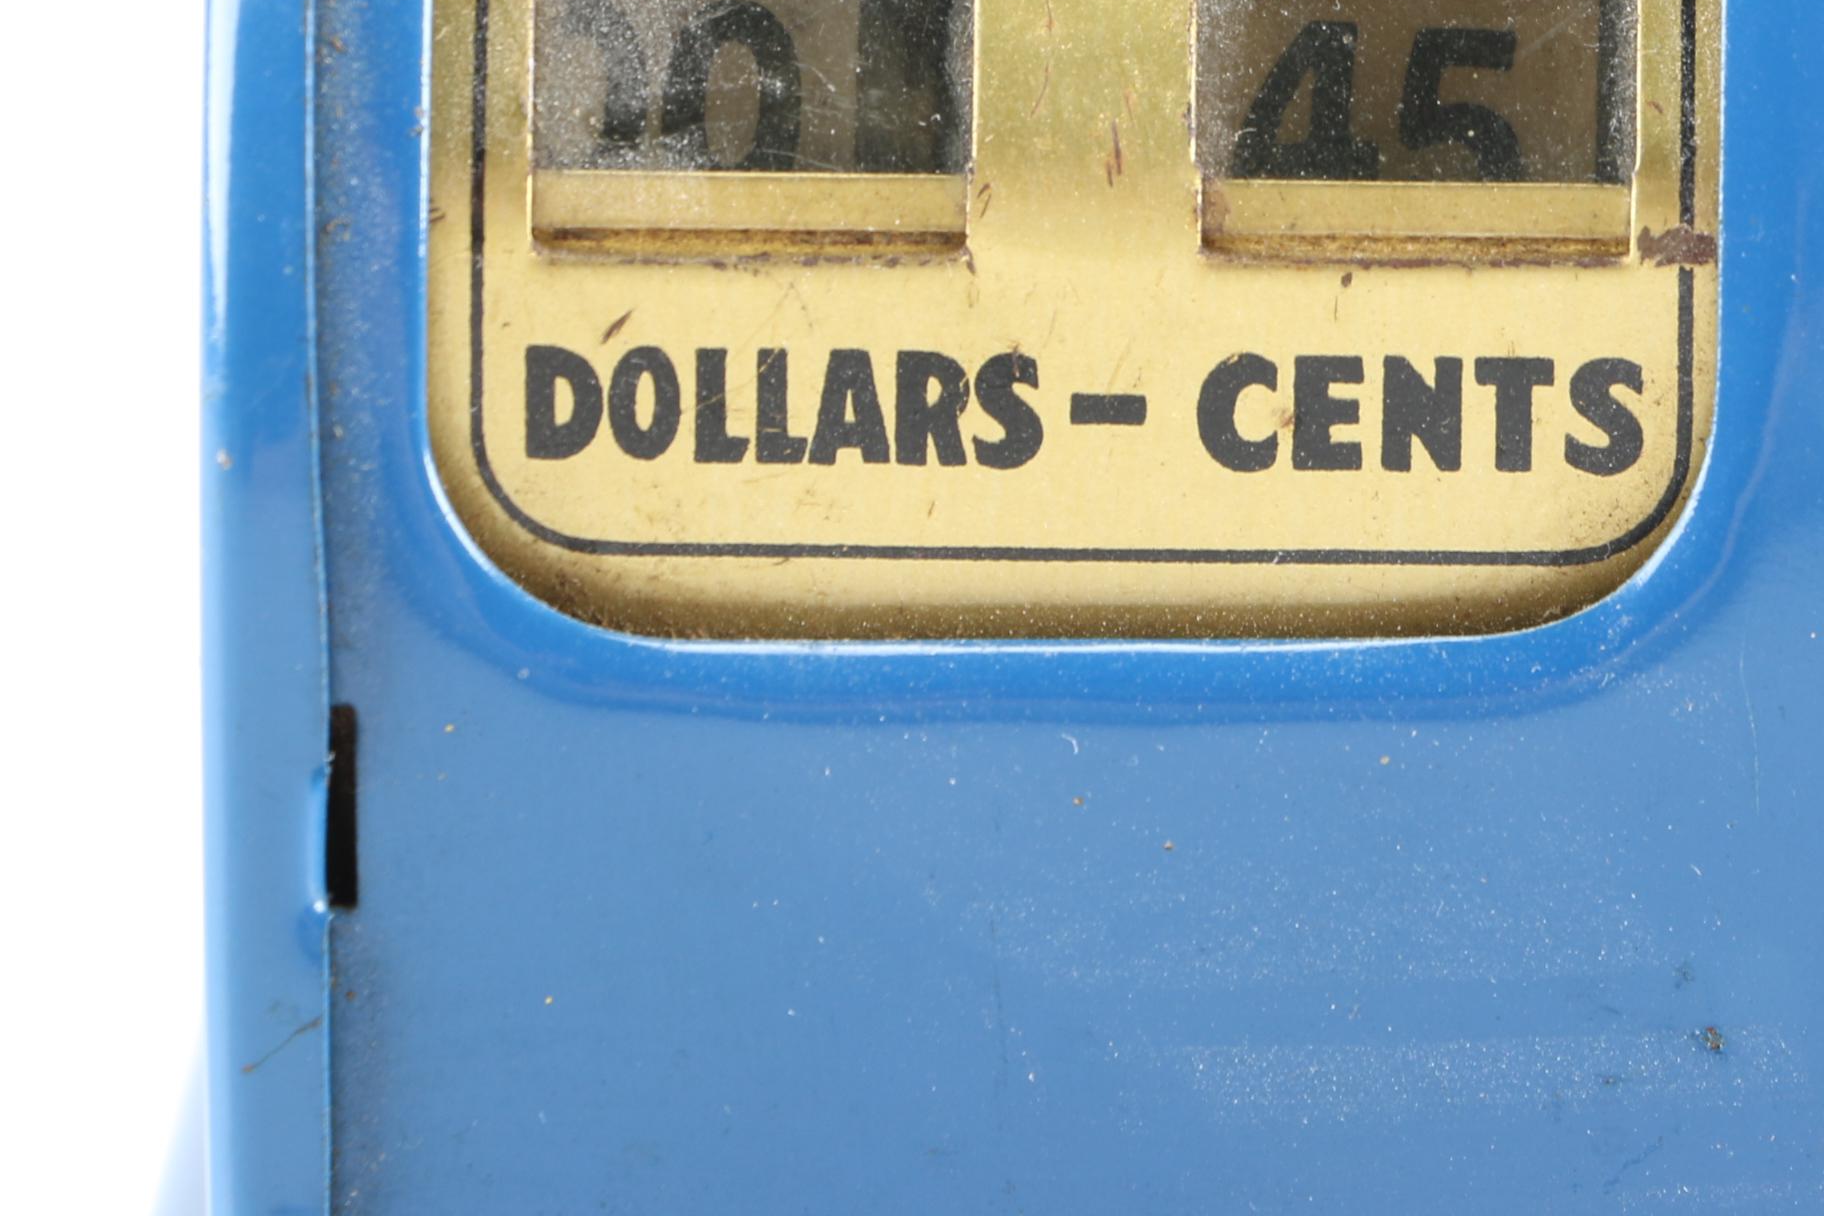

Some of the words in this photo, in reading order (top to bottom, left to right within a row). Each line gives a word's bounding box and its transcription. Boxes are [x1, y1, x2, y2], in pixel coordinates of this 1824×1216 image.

[1232, 20, 1527, 182] 45
[523, 344, 1044, 469] DOLLARS
[1196, 353, 1645, 476] CENTS
